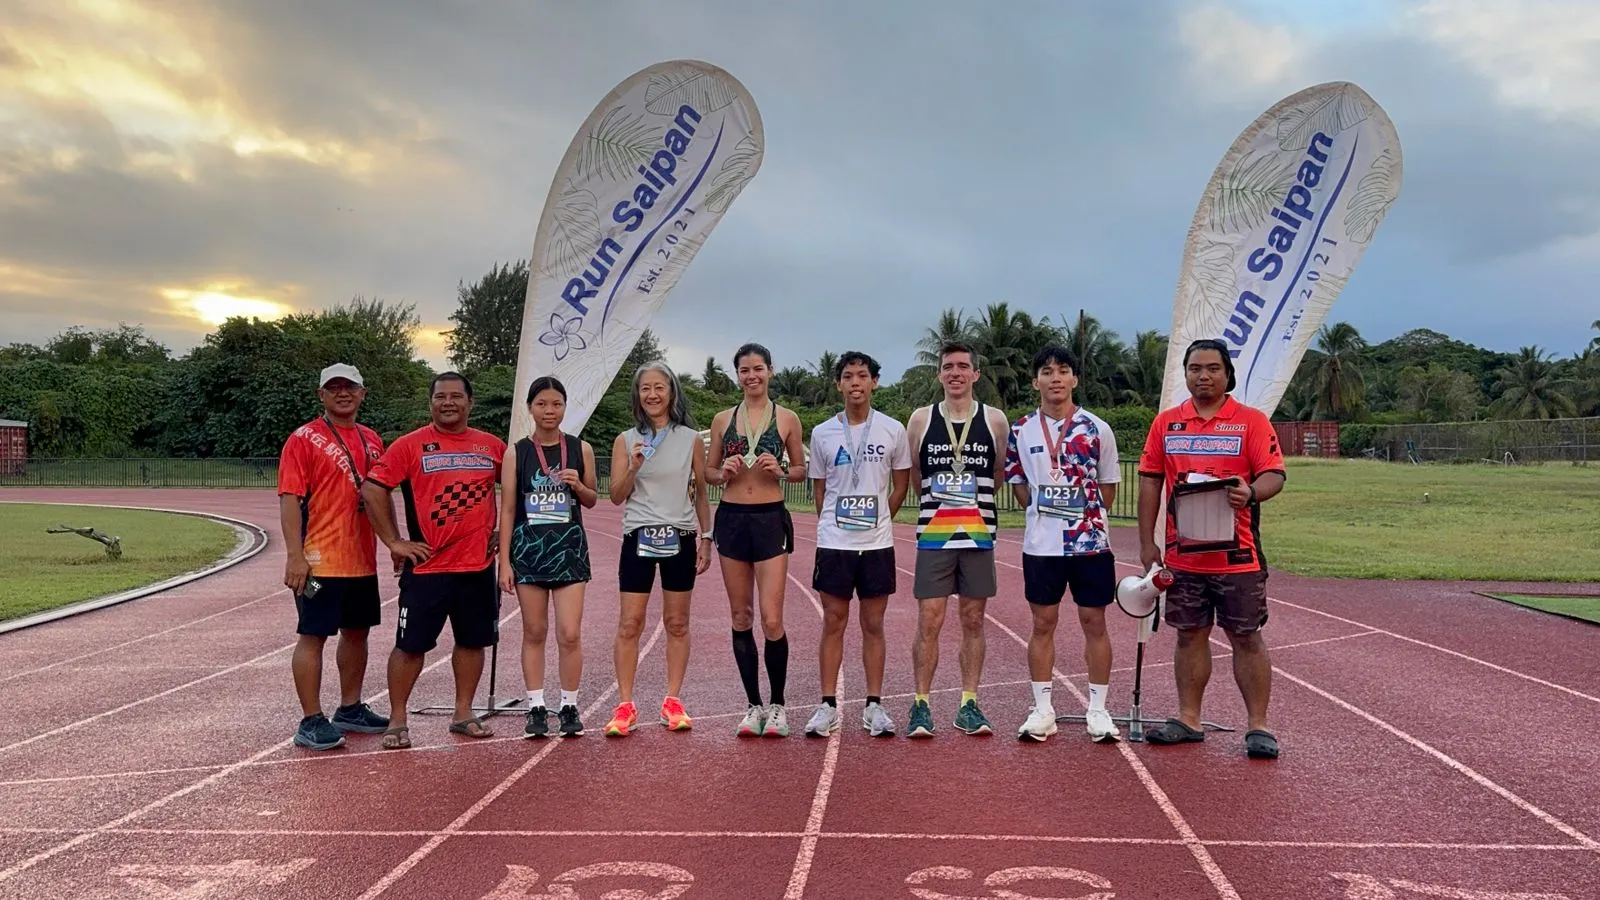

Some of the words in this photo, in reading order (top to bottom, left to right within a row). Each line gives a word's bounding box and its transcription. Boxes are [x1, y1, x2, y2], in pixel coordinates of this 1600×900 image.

[561, 237, 624, 317] Run
[612, 104, 702, 232] Saipan
[1222, 290, 1266, 358] un
[1247, 131, 1333, 281] Saipan
[637, 266, 663, 295] Est.
[1215, 423, 1247, 432] Simon
[928, 443, 970, 455] Spors
[972, 442, 989, 452] for
[1194, 439, 1236, 450] SAIPAN
[961, 455, 989, 468] Body
[937, 473, 972, 486] 0232
[530, 492, 566, 506] 0240
[1044, 487, 1079, 500] 0237
[841, 498, 874, 510] 0246
[644, 526, 674, 539] 0245
